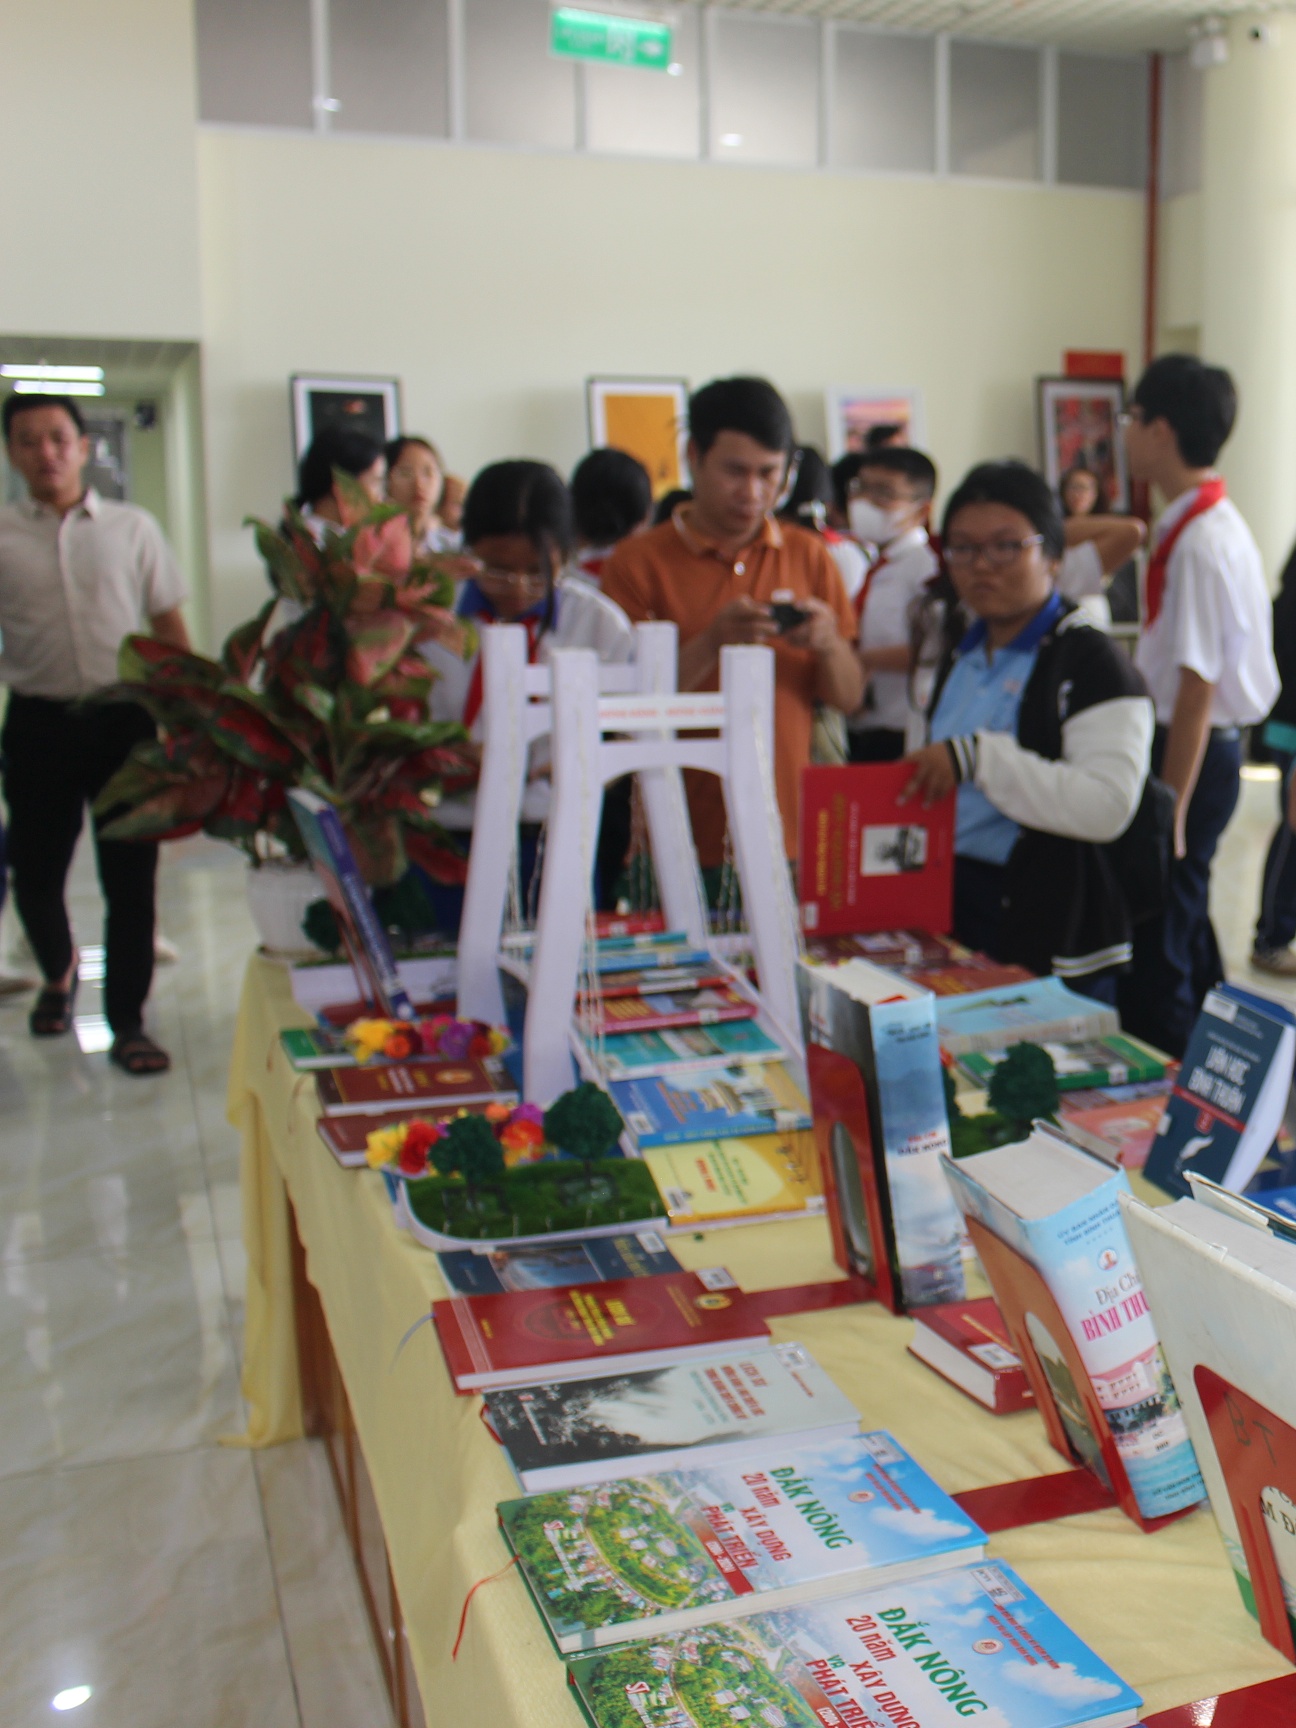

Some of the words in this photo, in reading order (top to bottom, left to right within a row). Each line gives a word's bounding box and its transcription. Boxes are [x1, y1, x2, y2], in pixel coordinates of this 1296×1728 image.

[1081, 1307, 1123, 1342] BÌNH
[1120, 1290, 1152, 1323] THU
[769, 1466, 814, 1500] ĐẮK
[795, 1500, 854, 1551] NÔNG
[845, 1614, 877, 1634] 20
[858, 1629, 897, 1662] năm
[848, 1659, 888, 1690] XÂY
[876, 1606, 933, 1652] ĐẮK
[912, 1650, 989, 1718] NÔNG
[805, 1657, 849, 1699] PHÁT
[834, 1697, 885, 1728] TRIỂ
